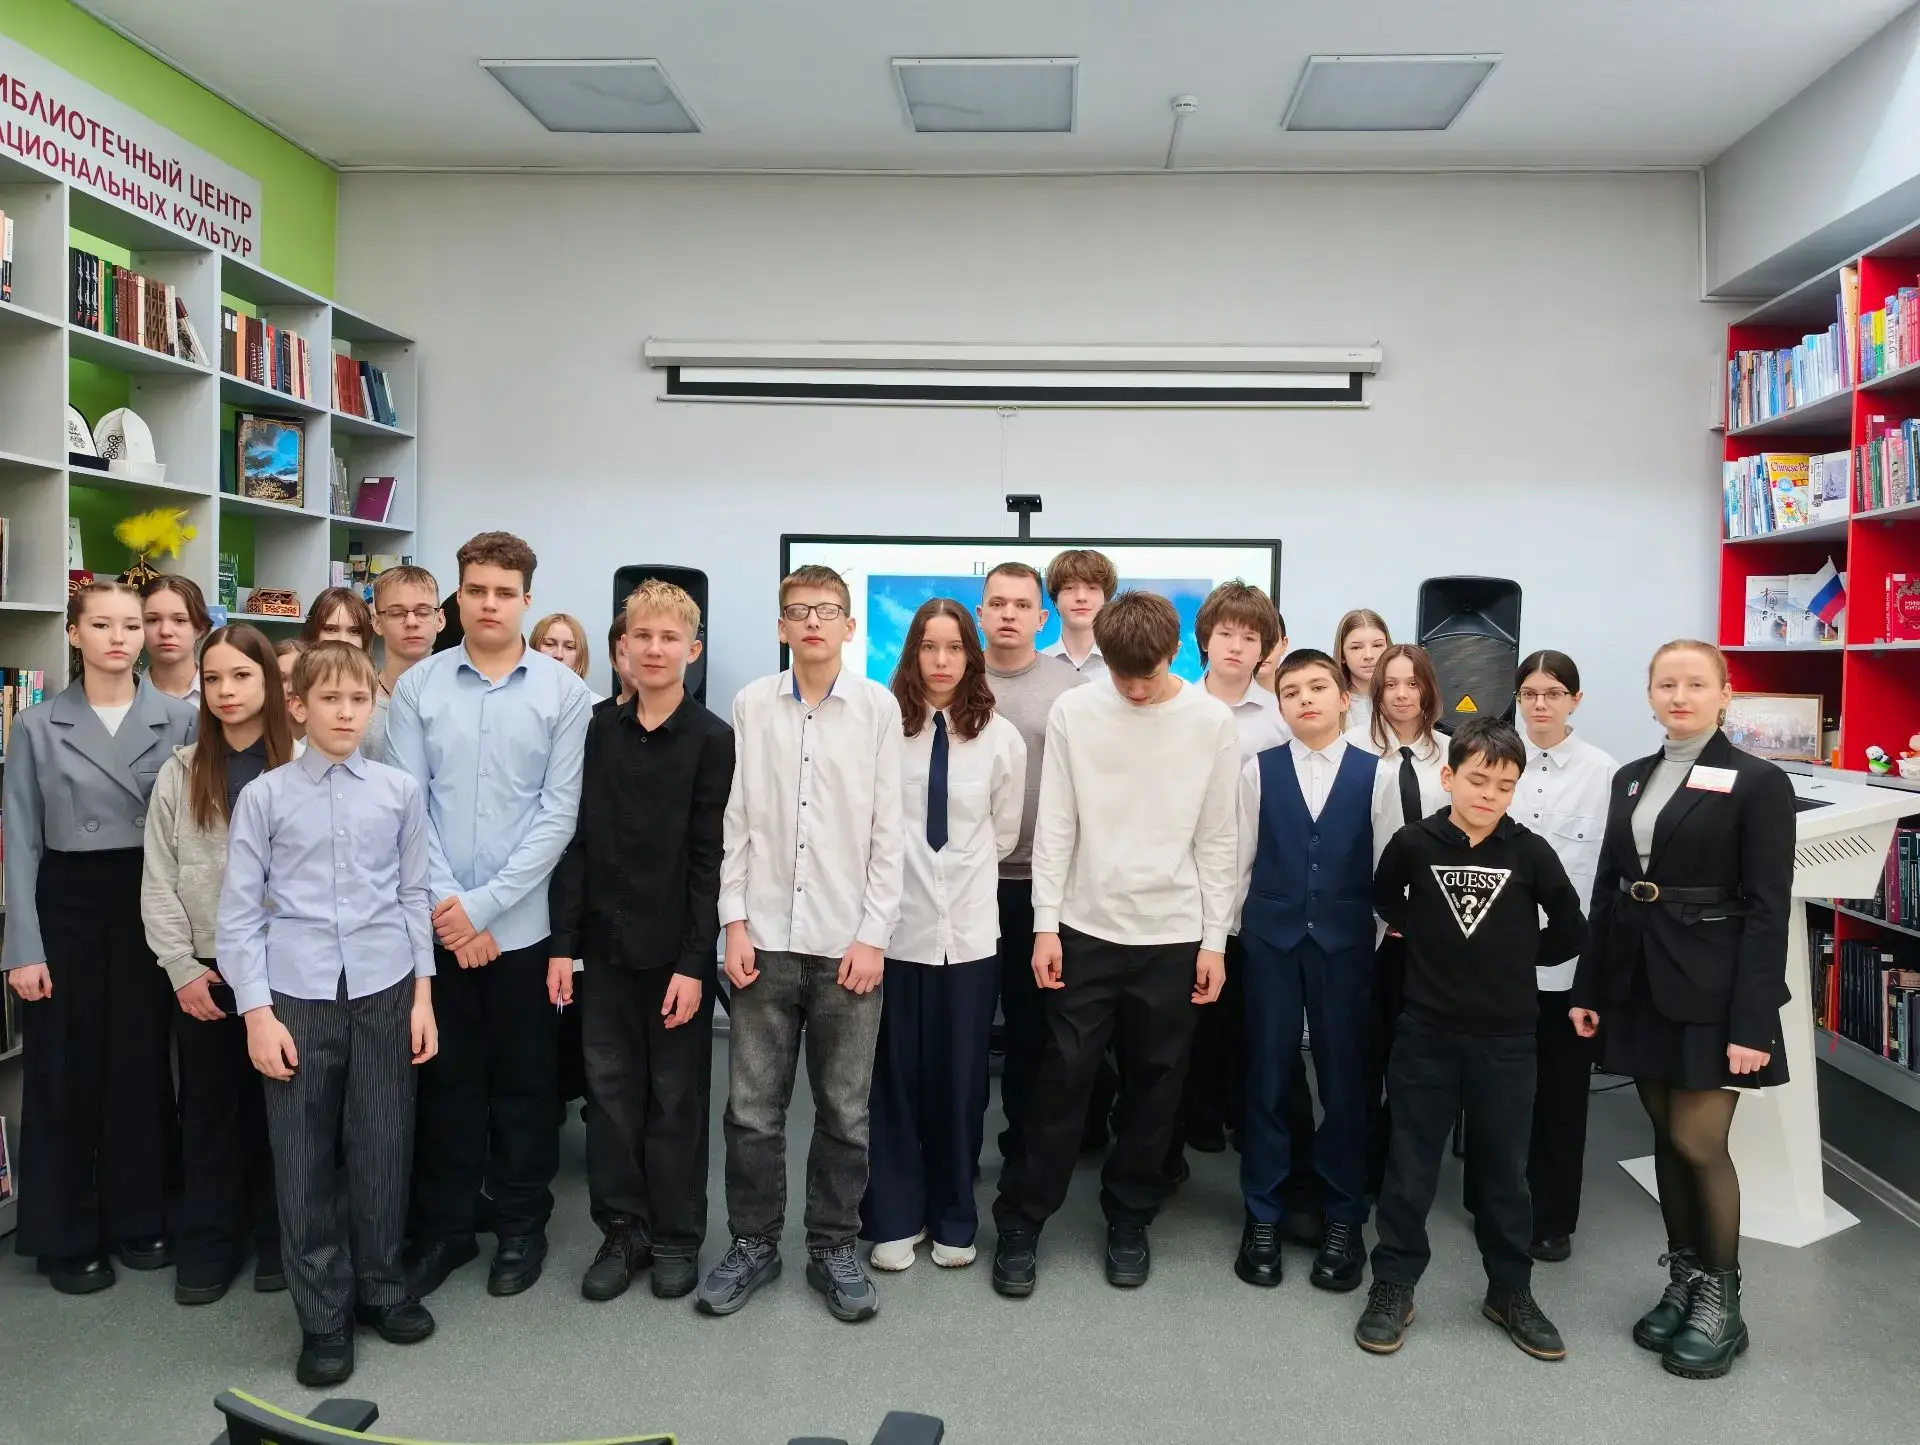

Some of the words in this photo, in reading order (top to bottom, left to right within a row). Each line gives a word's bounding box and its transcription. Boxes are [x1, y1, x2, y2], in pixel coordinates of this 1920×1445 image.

[190, 174, 252, 225] ЦЕНТР
[173, 203, 252, 258] КУЛЬТУР
[1442, 871, 1497, 889] GUESS
